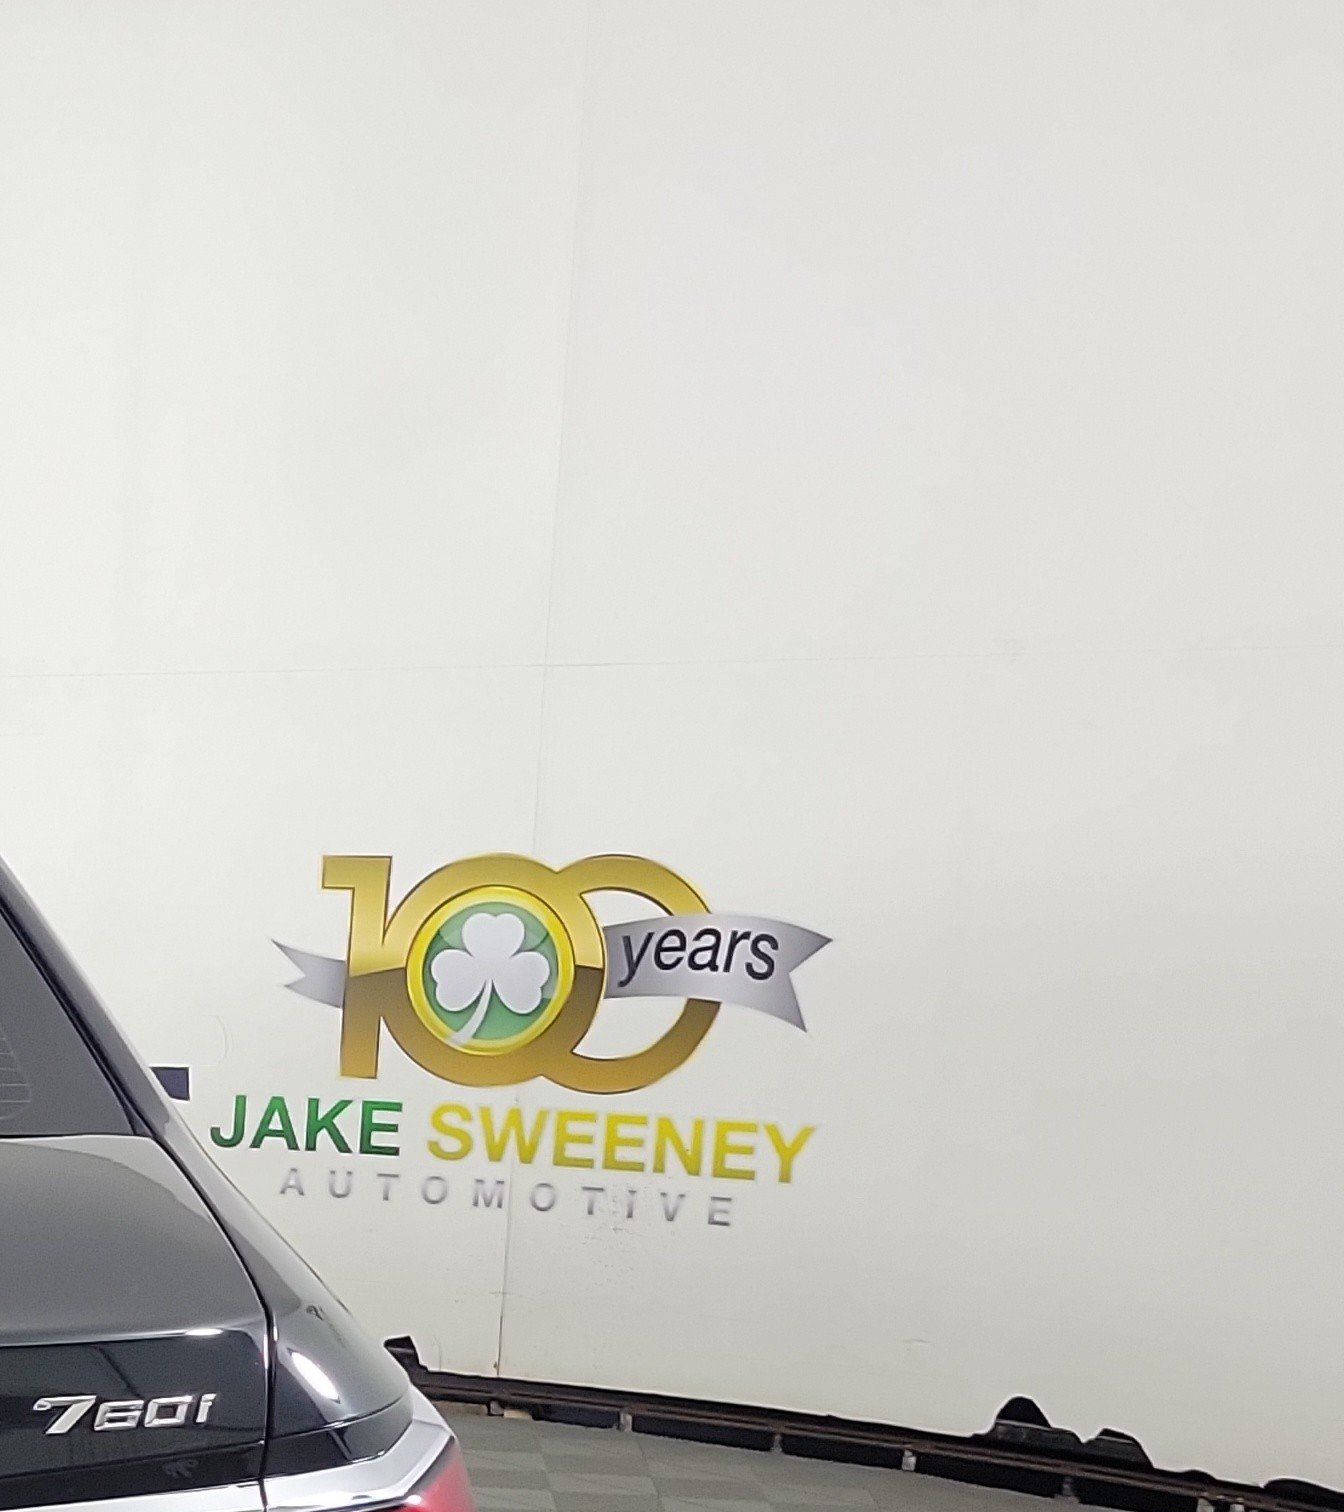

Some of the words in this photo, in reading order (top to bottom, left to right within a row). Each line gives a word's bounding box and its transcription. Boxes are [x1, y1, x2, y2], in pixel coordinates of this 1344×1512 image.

[617, 927, 780, 988] years
[210, 1095, 404, 1157] JAKE
[427, 1104, 817, 1184] SWEENEY
[279, 1167, 733, 1228] AUTOMOTIVE
[32, 1393, 217, 1435] 760i
